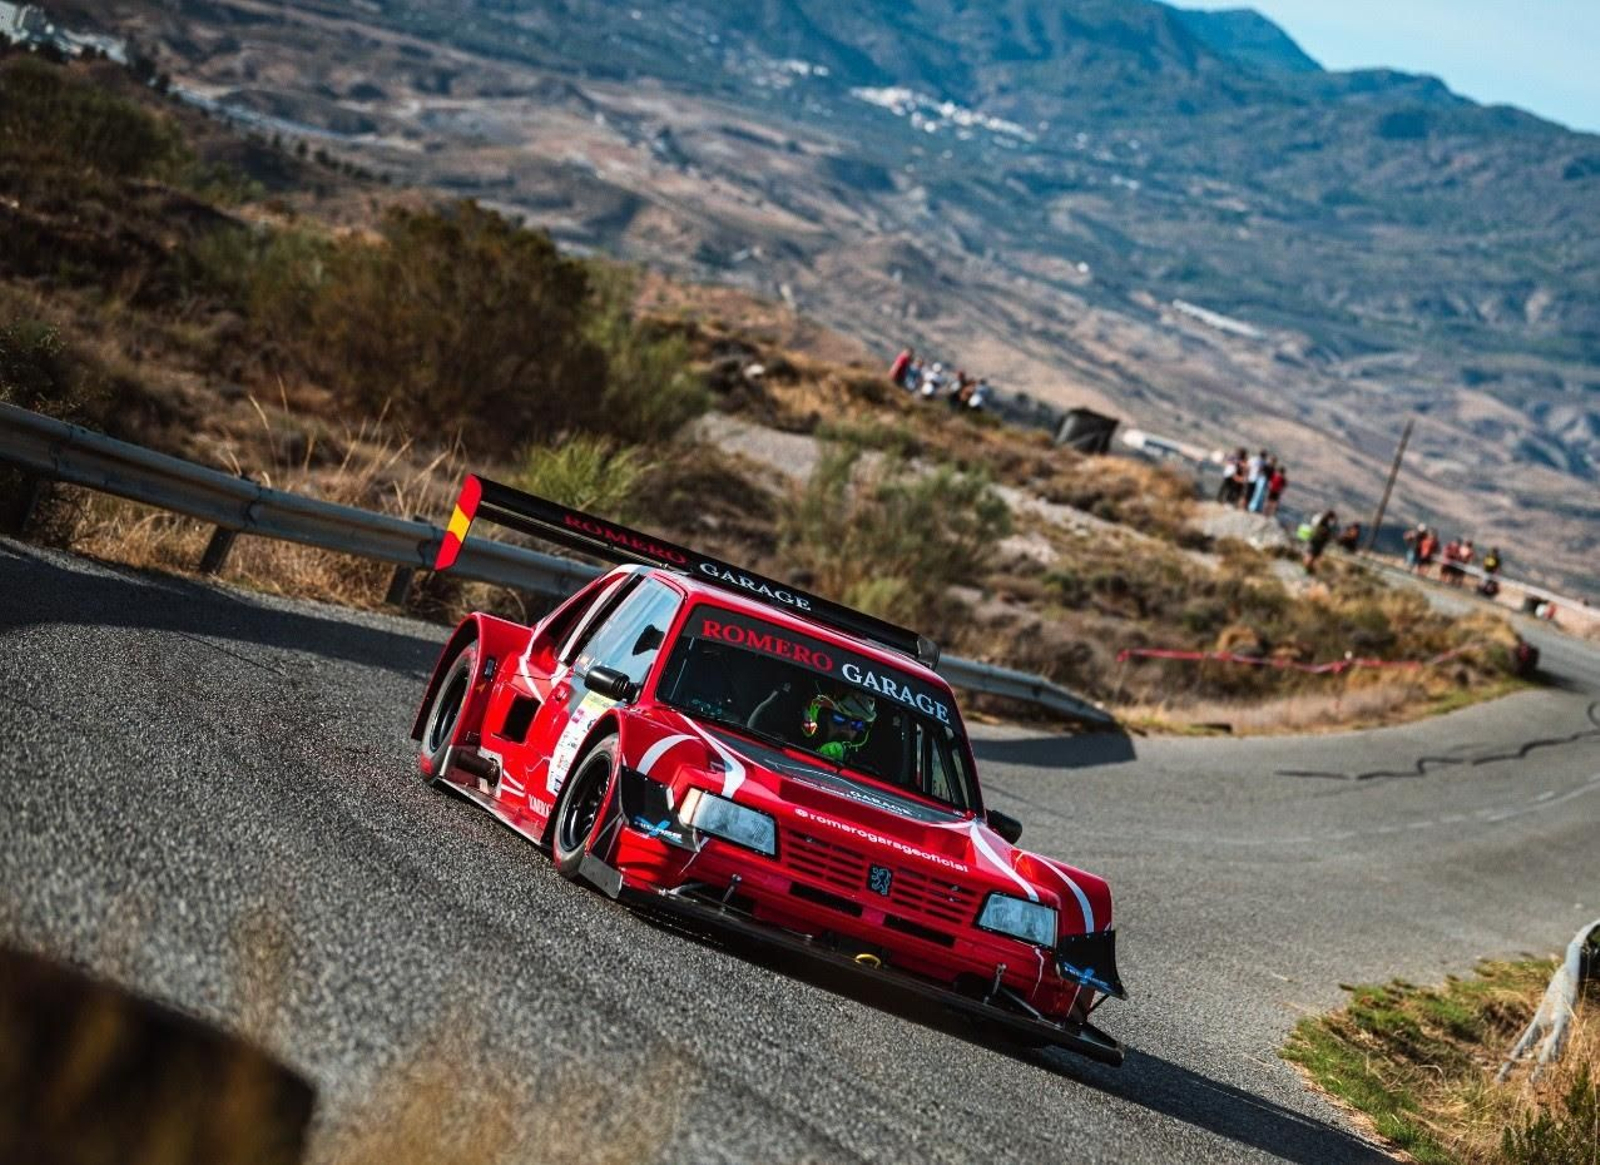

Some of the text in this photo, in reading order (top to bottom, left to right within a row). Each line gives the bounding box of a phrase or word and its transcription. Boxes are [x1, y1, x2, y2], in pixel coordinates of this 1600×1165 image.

[562, 514, 812, 611] ROMERO GARAGE
[701, 620, 950, 724] ROMERO GARAGE
